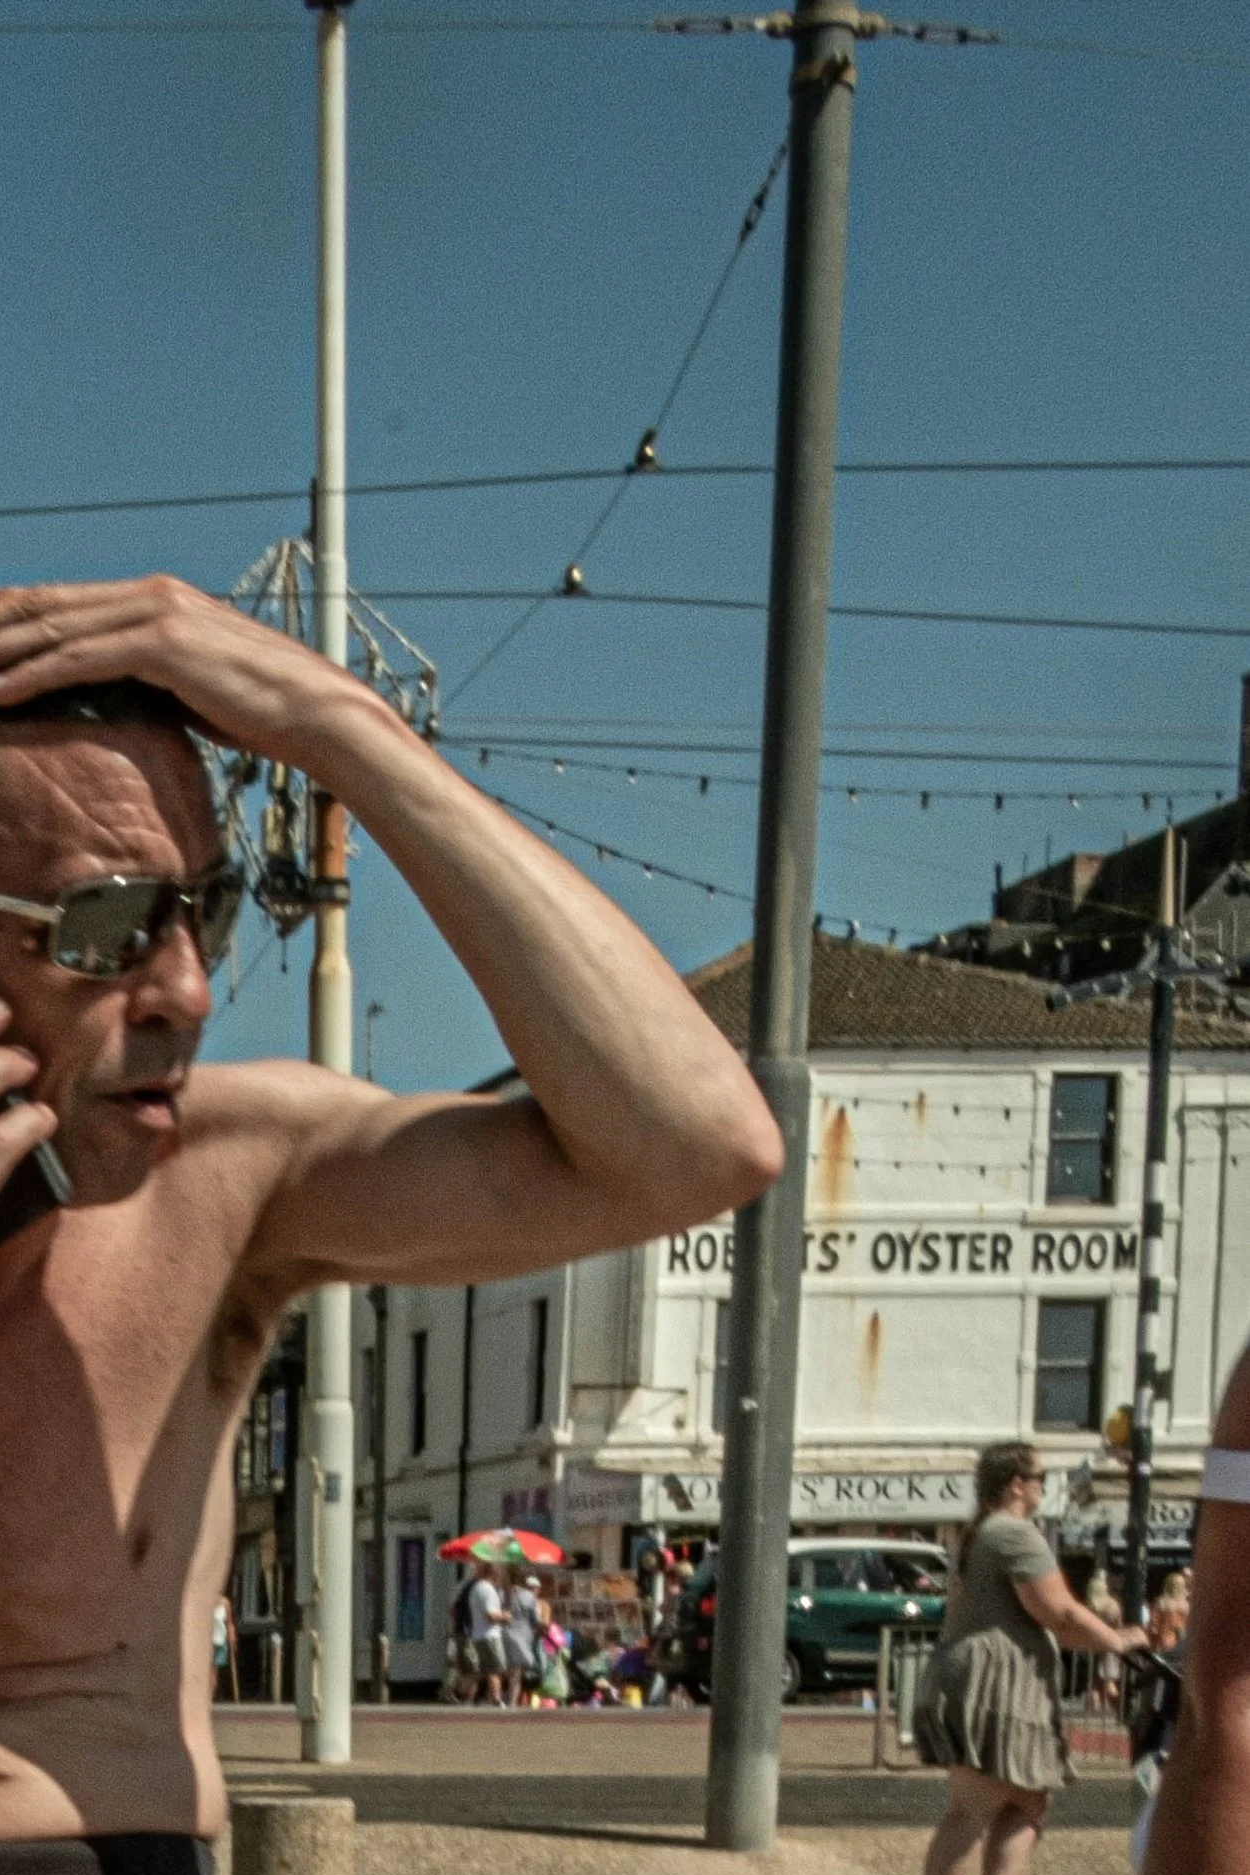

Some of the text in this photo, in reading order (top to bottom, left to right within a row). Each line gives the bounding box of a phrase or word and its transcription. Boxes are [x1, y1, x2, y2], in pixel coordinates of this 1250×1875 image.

[870, 1231, 1013, 1273] OYSTER
[1031, 1232, 1138, 1273] ROOM
[836, 1474, 927, 1502] ROCK
[938, 1474, 962, 1502] &
